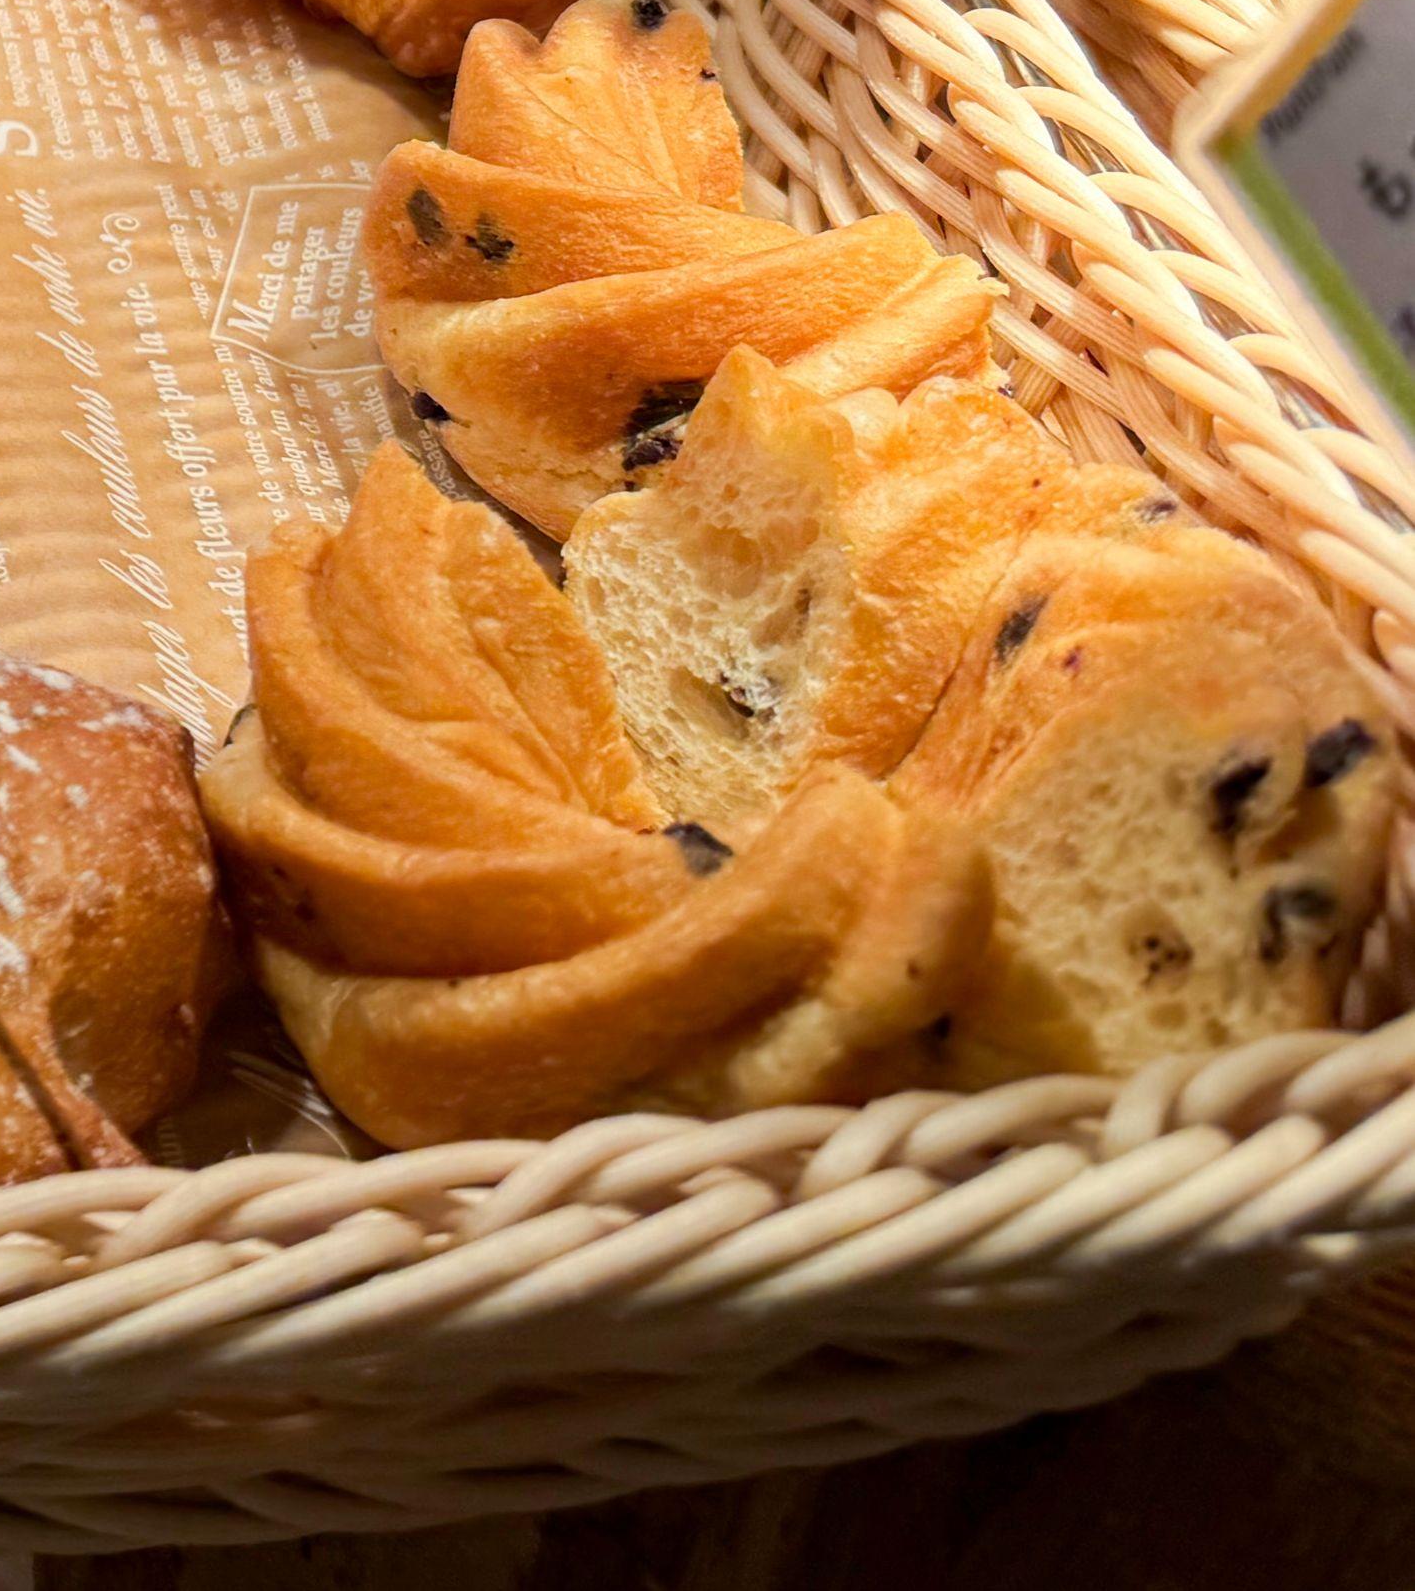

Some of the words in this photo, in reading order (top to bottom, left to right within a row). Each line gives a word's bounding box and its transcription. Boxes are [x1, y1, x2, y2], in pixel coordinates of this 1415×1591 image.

[90, 129, 114, 159] que
[263, 89, 298, 150] couleurs
[172, 225, 200, 279] sourire
[226, 271, 283, 341] Merci
[263, 240, 290, 269] de
[277, 201, 300, 234] me
[289, 226, 331, 320] partager
[324, 207, 363, 300] couleurs
[12, 240, 86, 326] votre
[133, 331, 166, 355] la
[310, 305, 341, 340] les
[35, 330, 102, 377] de
[149, 357, 193, 402] par
[224, 368, 258, 426] sourire
[61, 384, 151, 539] couleurs
[161, 407, 218, 478] offert
[245, 430, 273, 475] votre
[186, 485, 237, 561] fleurs
[97, 550, 175, 609] les
